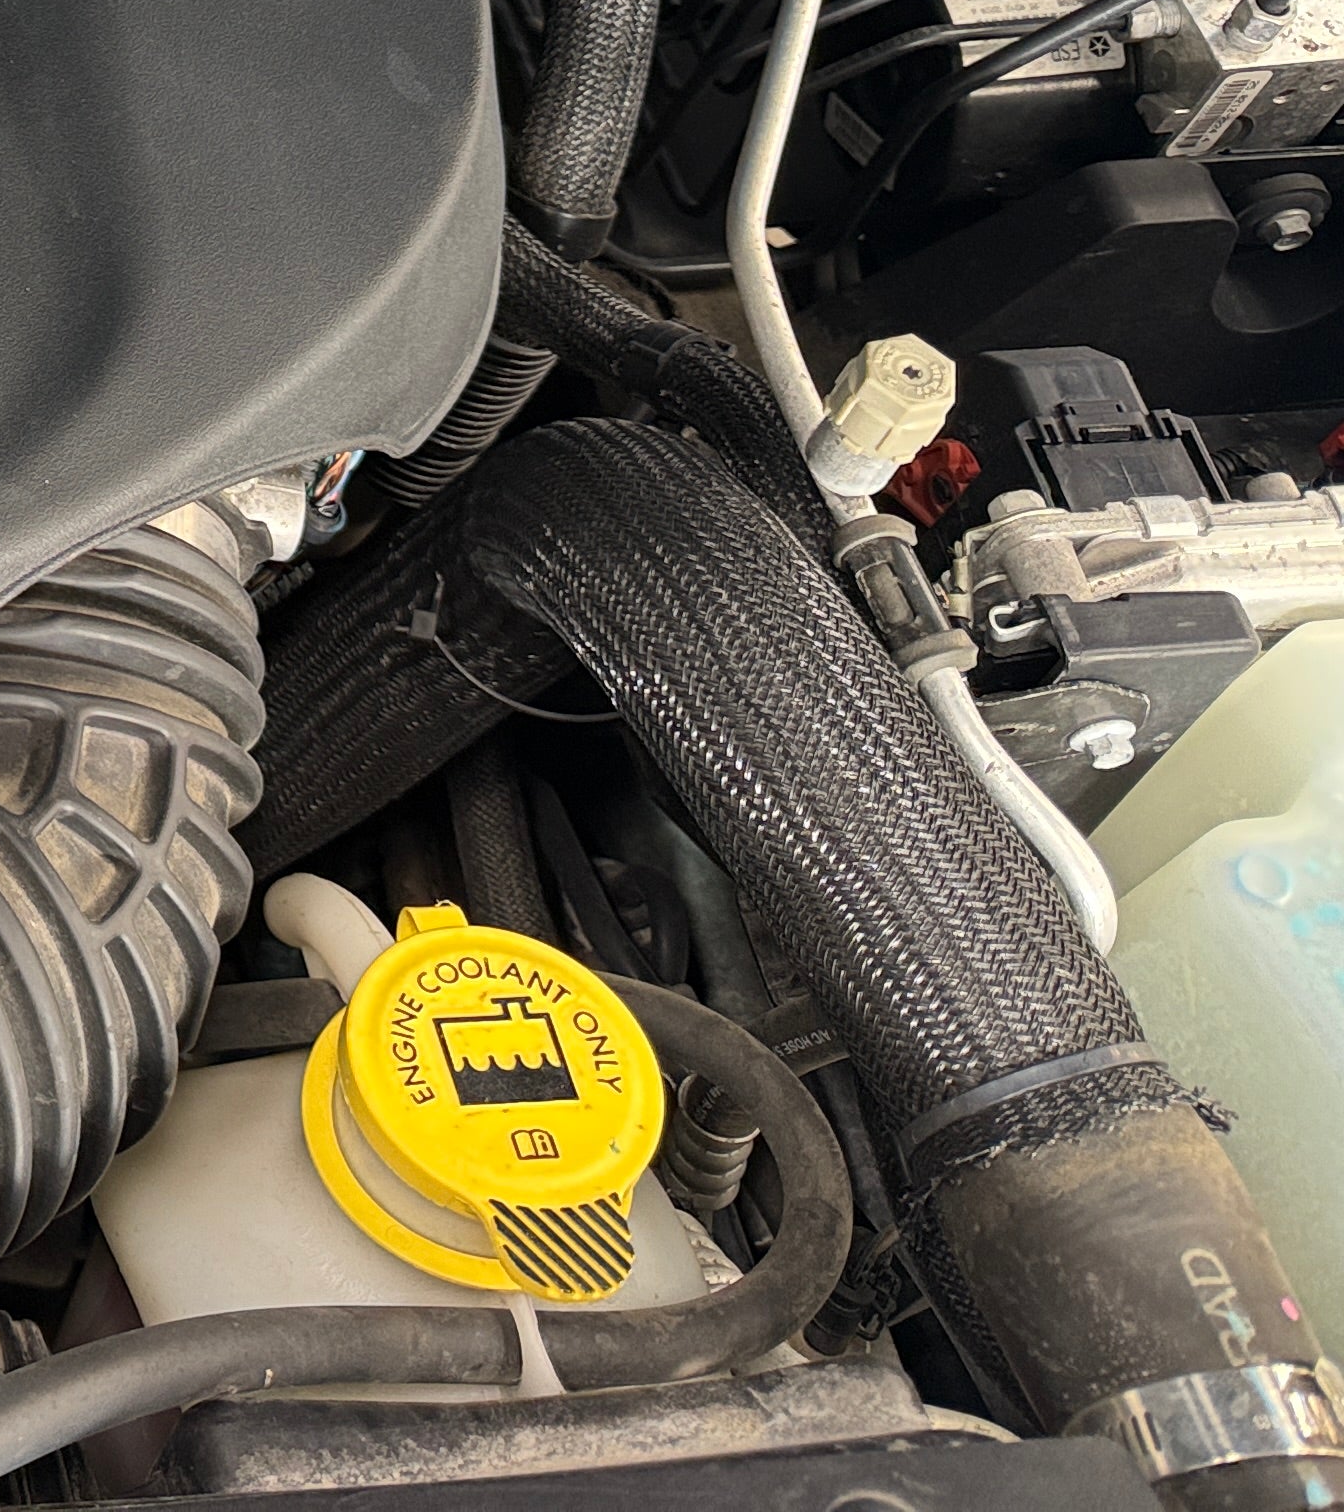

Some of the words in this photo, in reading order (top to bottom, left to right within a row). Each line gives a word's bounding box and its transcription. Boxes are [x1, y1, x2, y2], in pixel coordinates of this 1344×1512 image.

[391, 993, 435, 1105] ENGINE
[417, 957, 571, 1004] COOLANT
[573, 1011, 623, 1094] ONLY
[781, 1035, 813, 1055] HOSE
[811, 1028, 831, 1045] A/C
[1180, 1248, 1268, 1367] RAD
